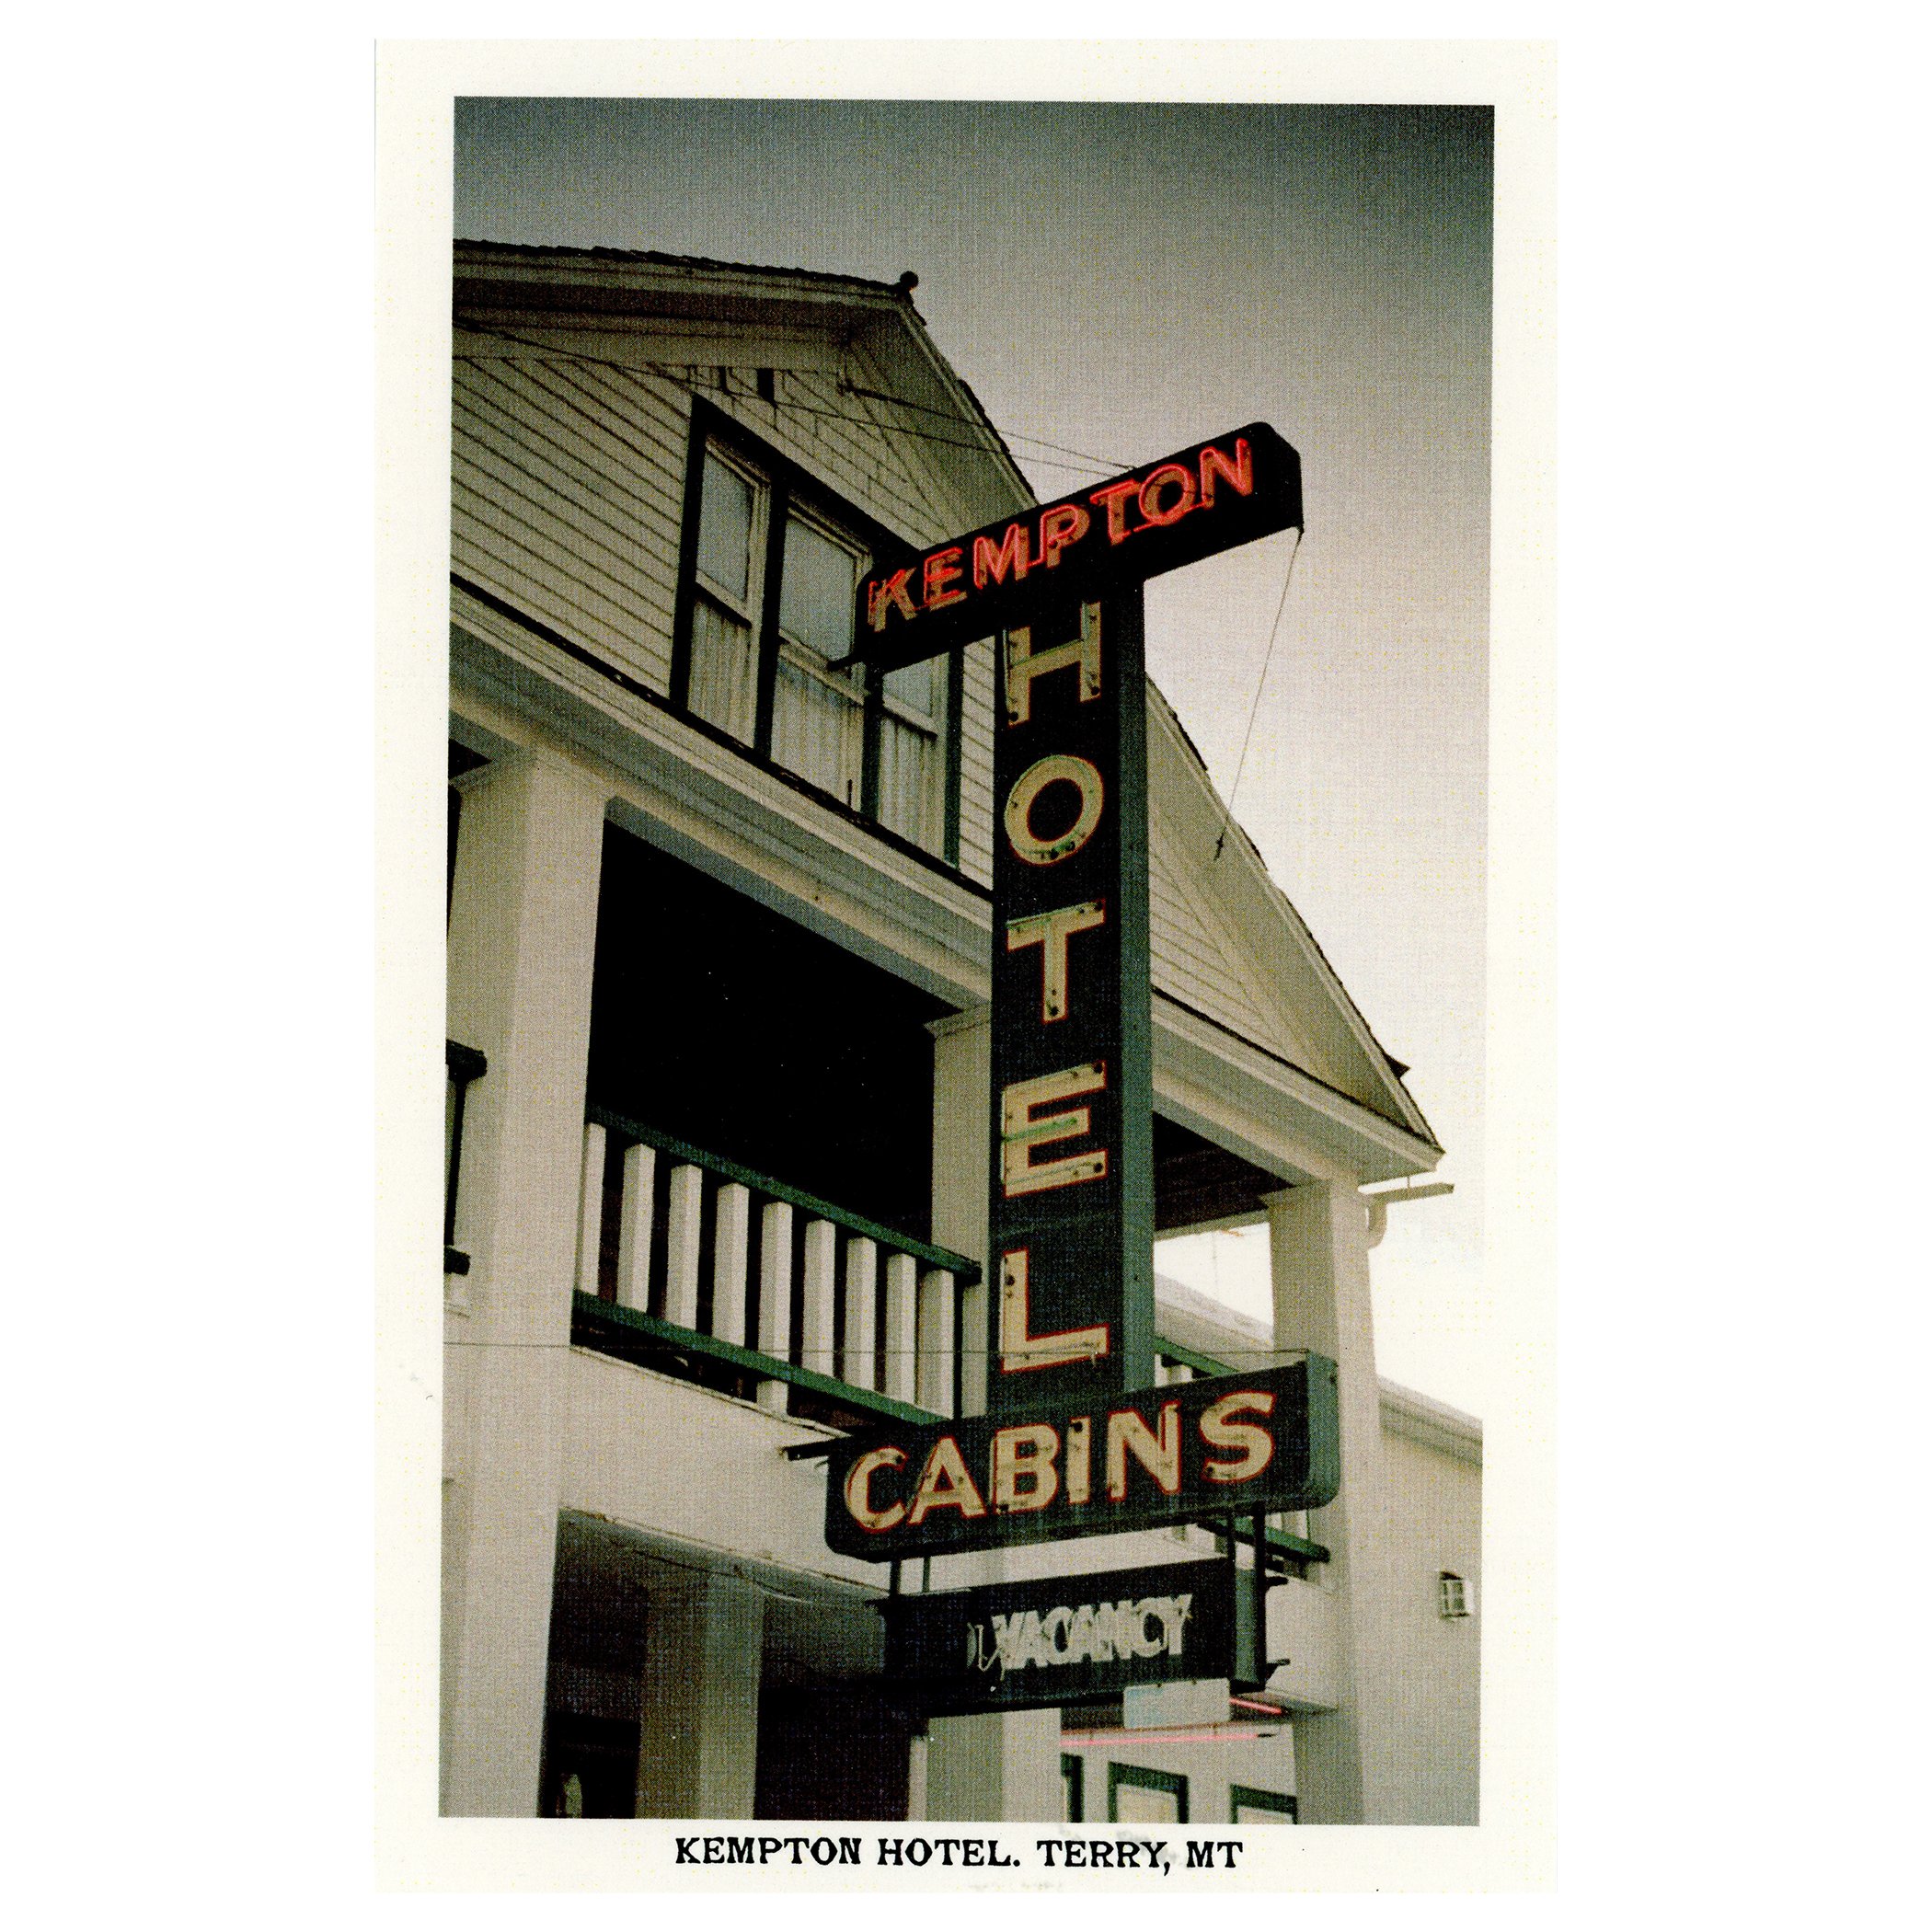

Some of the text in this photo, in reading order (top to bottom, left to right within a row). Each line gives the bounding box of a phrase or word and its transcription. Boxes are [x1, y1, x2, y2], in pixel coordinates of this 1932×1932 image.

[867, 438, 1254, 632] KEMPTON
[1000, 601, 1110, 1374] HOTEL
[845, 1389, 1277, 1534] CABINS
[991, 1593, 1192, 1670] VACANCY
